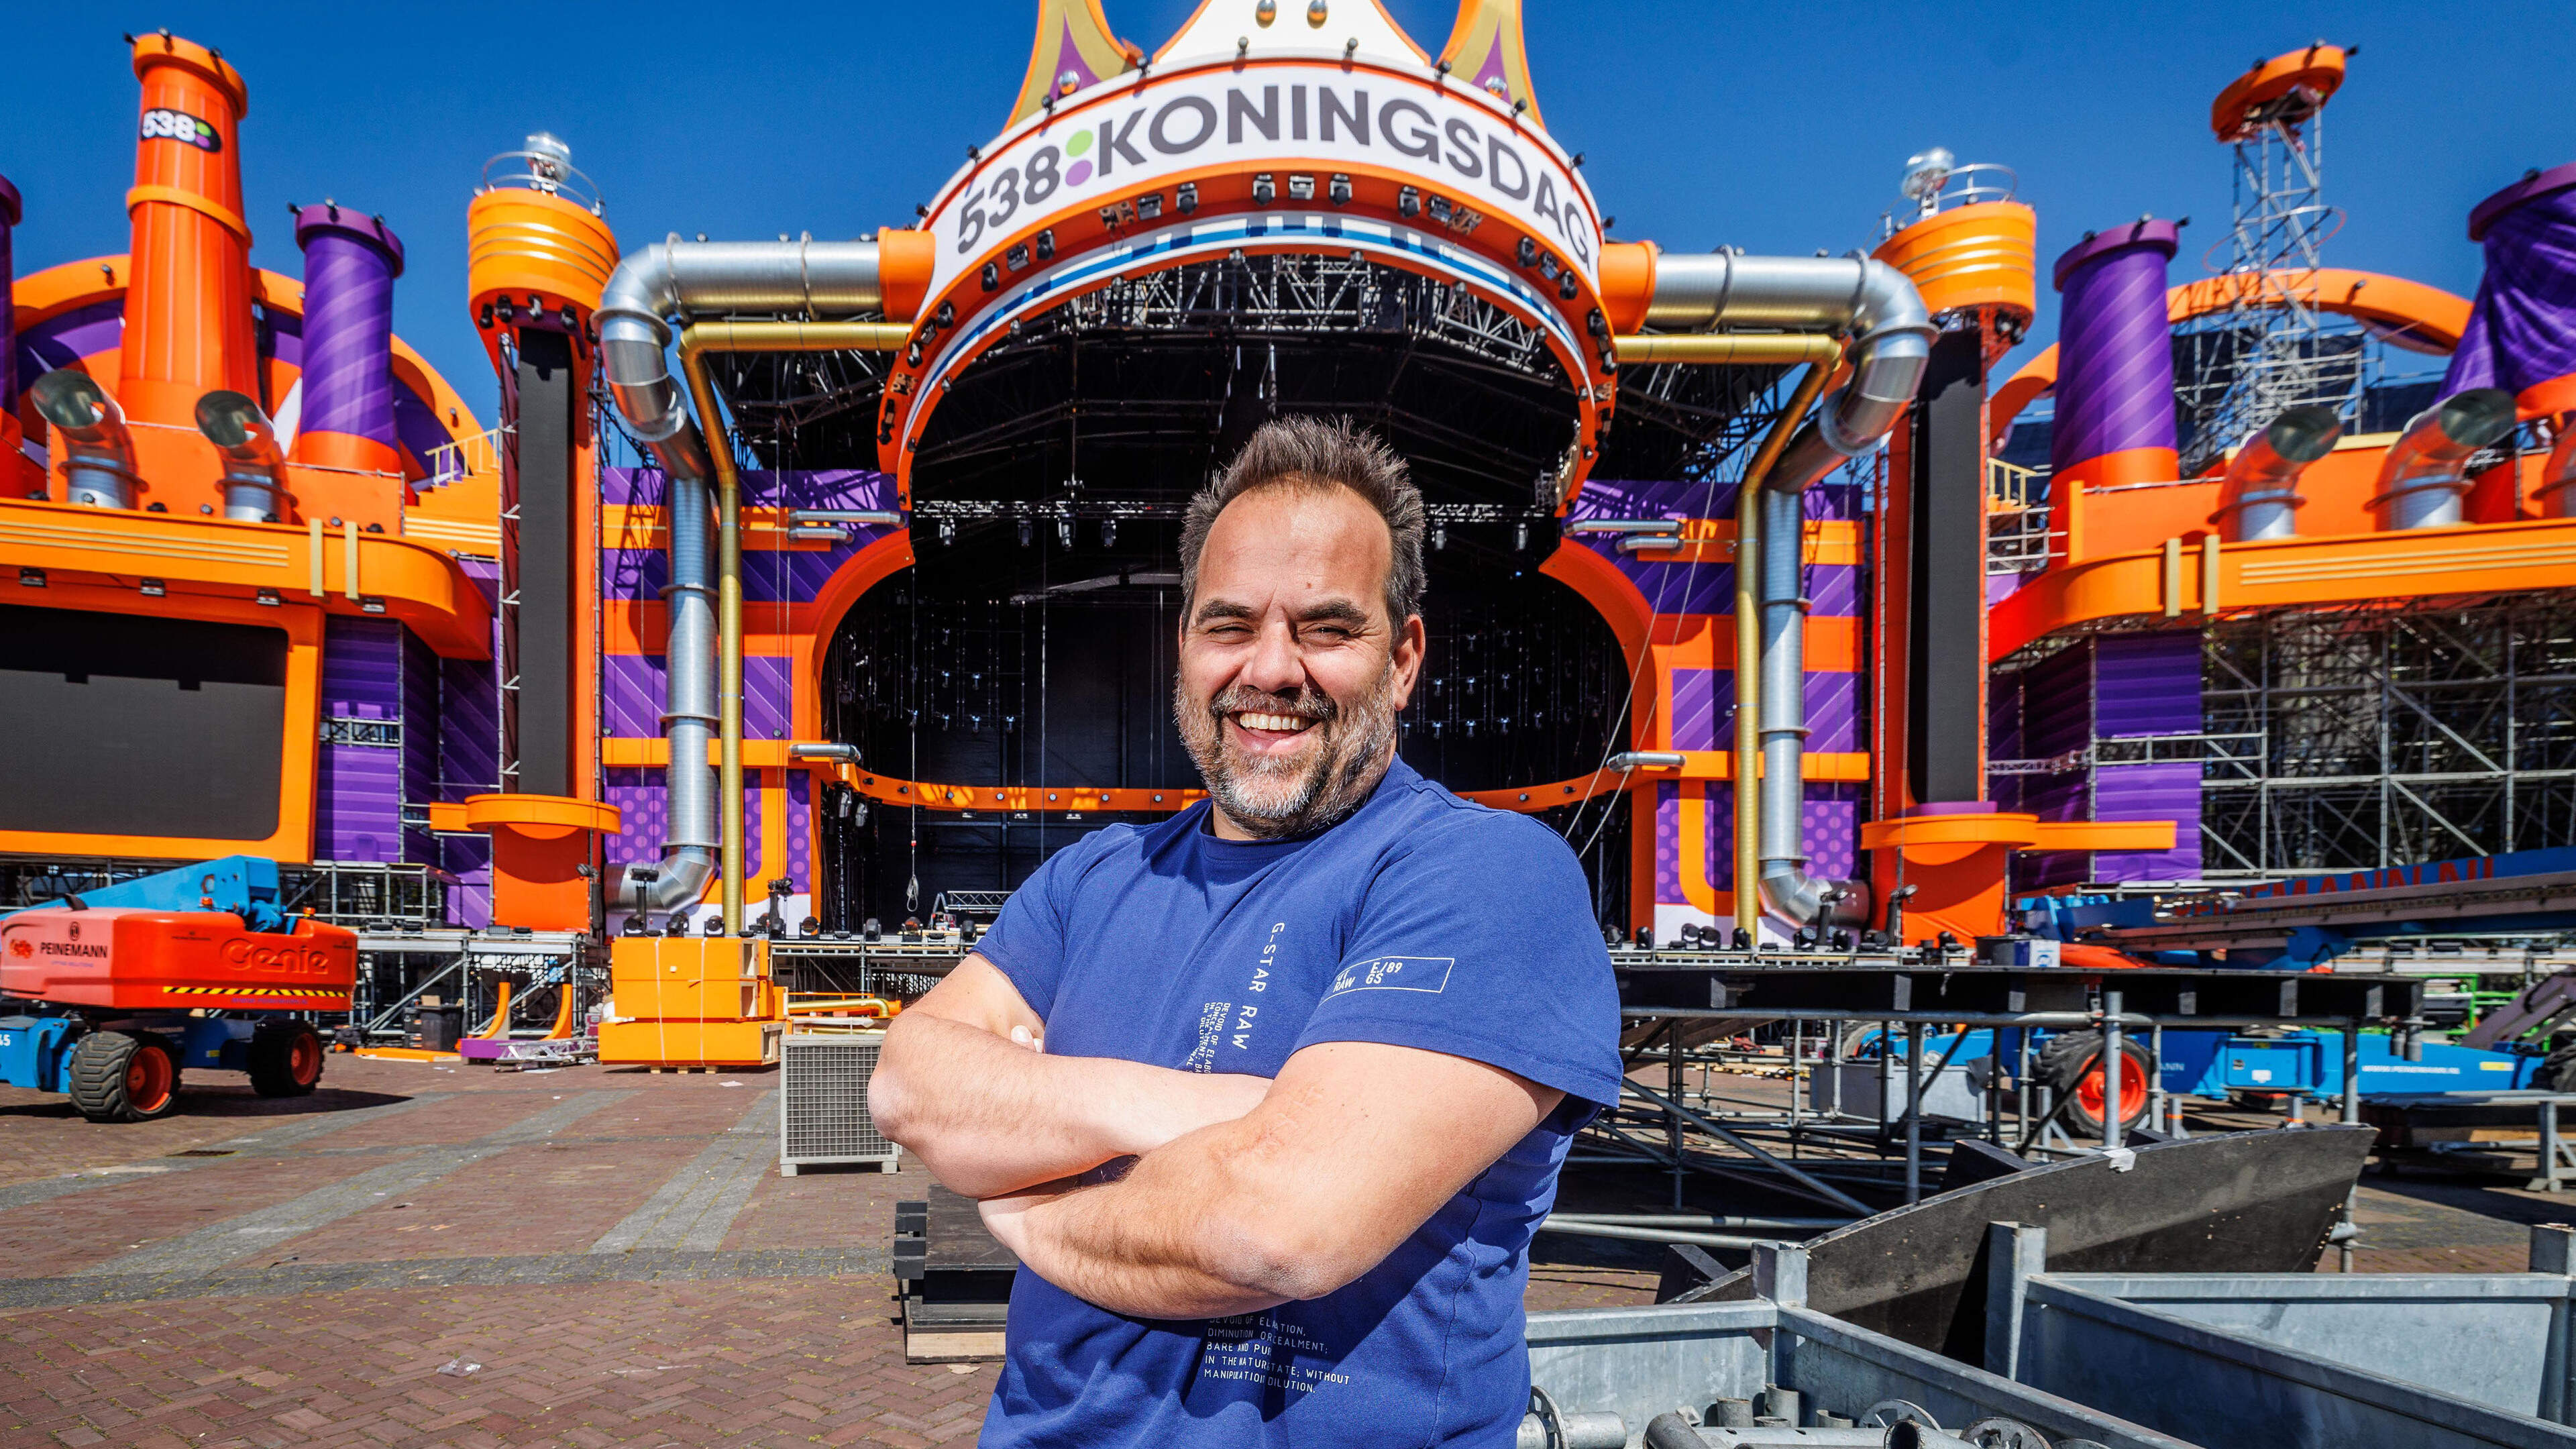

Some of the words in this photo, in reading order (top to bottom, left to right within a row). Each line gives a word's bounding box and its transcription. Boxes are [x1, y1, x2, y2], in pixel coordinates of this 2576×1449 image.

[142, 110, 196, 142] 538
[957, 146, 1061, 254] 538
[1098, 86, 1592, 273] KONINGSDAG
[40, 942, 108, 958] PEINEMANN
[220, 938, 329, 975] Genie
[1249, 922, 1285, 992] G-STAR
[1333, 977, 1356, 993] RAW
[1366, 973, 1383, 984] GS
[1215, 1003, 1231, 1031] DEVOID
[1232, 1006, 1258, 1050] RAW
[1210, 1035, 1218, 1046] OF
[1208, 1328, 1254, 1338] DIMINUTION
[1210, 1316, 1242, 1325] DEVOID
[1245, 1316, 1254, 1324] OF
[1207, 1342, 1233, 1352] BARE
[1237, 1343, 1248, 1352] AND
[1205, 1355, 1215, 1364] IN
[1222, 1356, 1237, 1366] THE
[1306, 1368, 1350, 1385] WITHOUT
